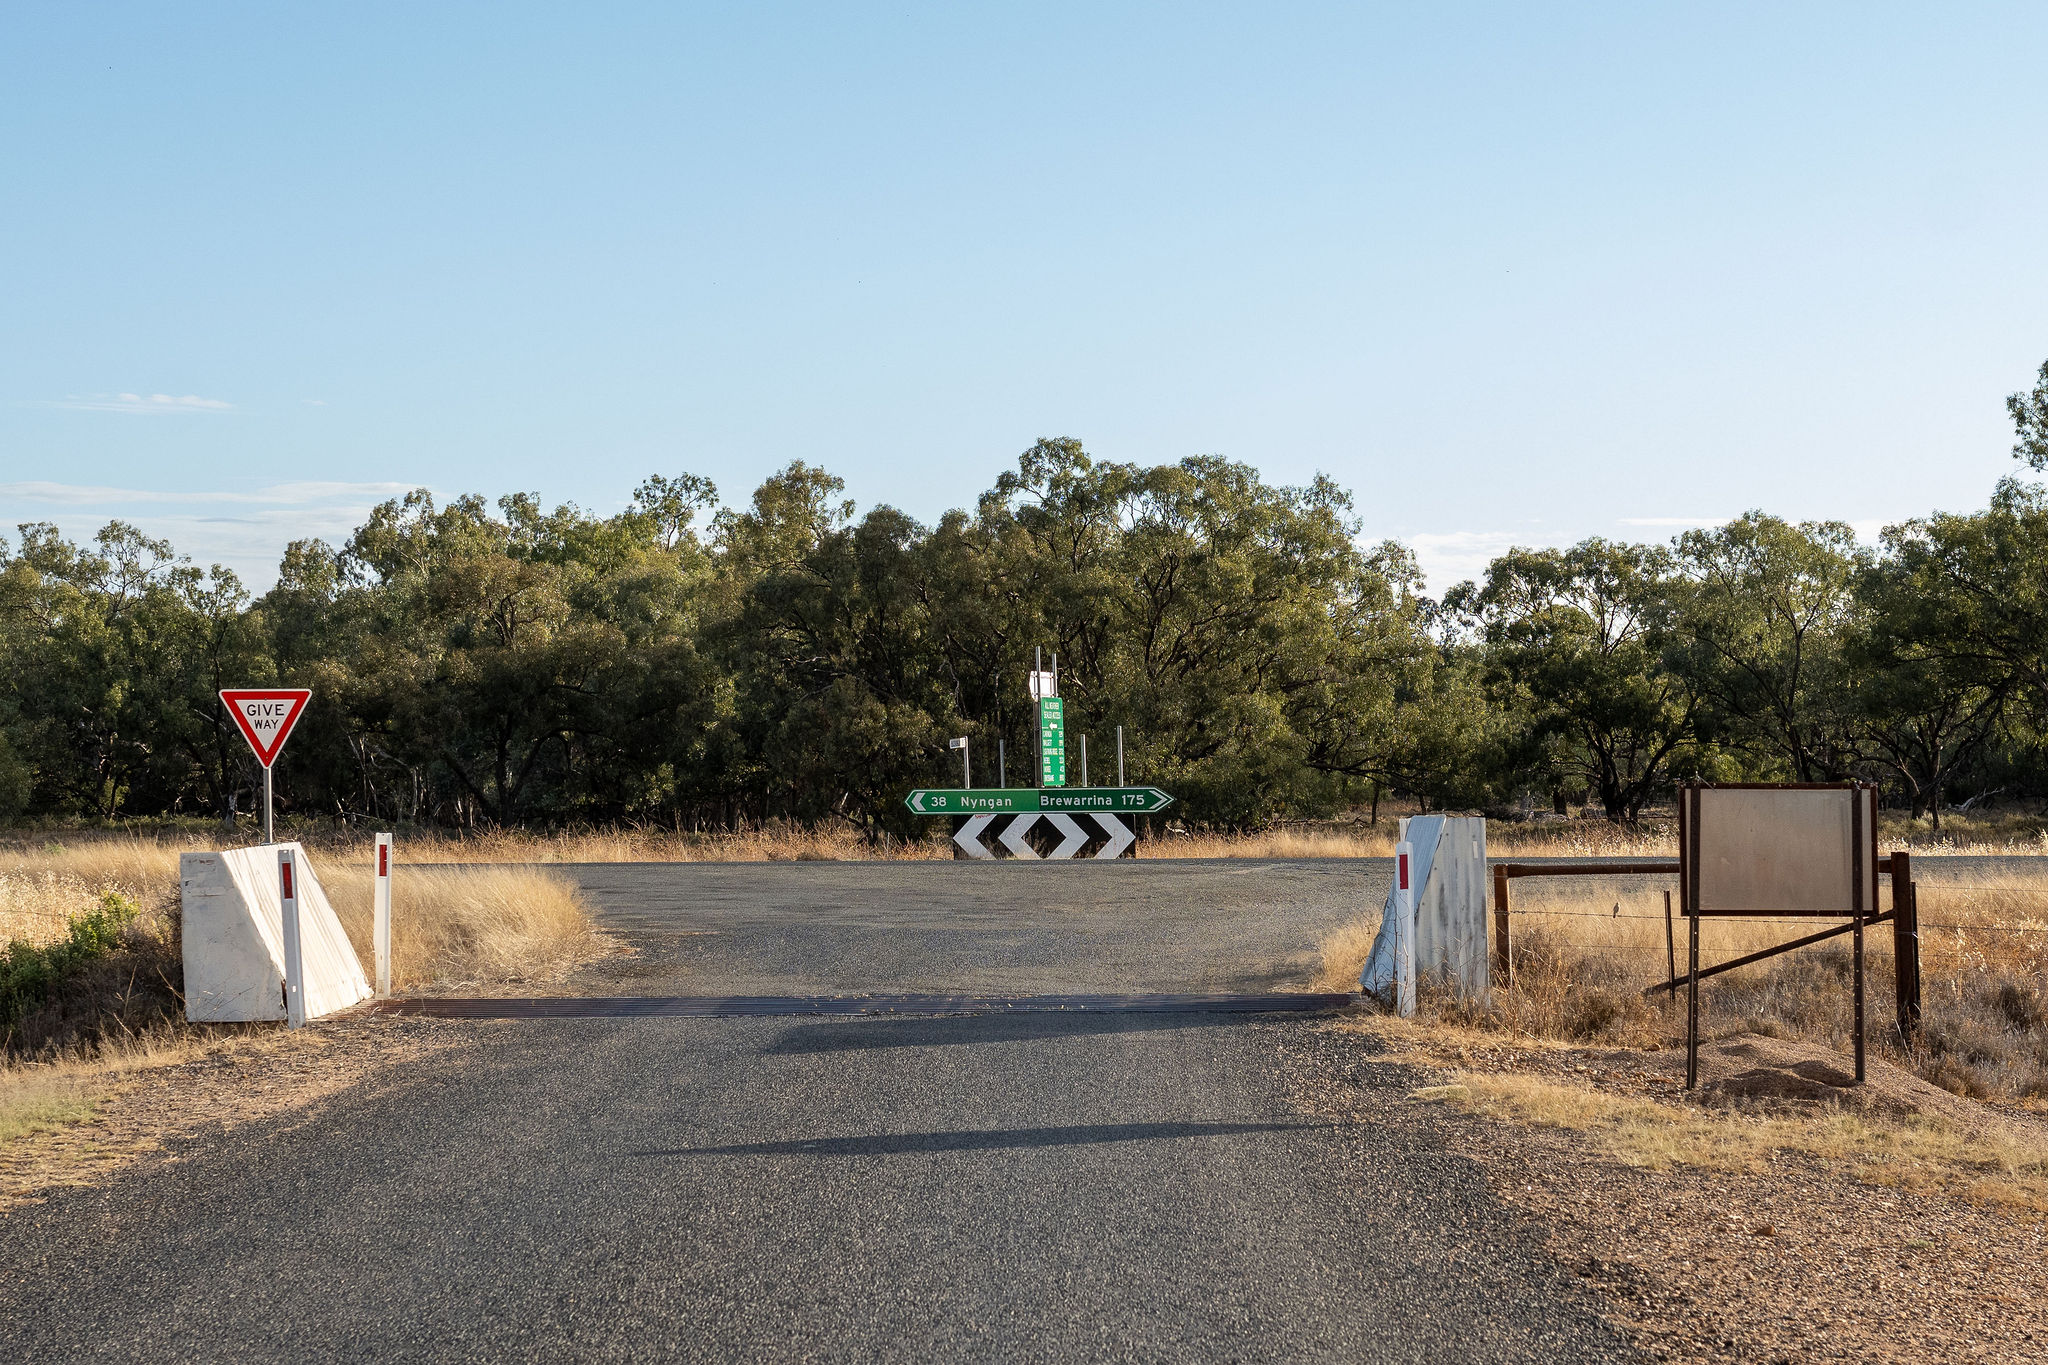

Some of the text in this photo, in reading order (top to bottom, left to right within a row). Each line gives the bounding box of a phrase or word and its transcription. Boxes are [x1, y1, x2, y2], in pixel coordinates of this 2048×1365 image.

[246, 704, 285, 717] GIVE
[254, 719, 279, 730] WAY
[930, 796, 1013, 810] 38 Nyngan
[1040, 794, 1145, 807] Brewarrina 175
